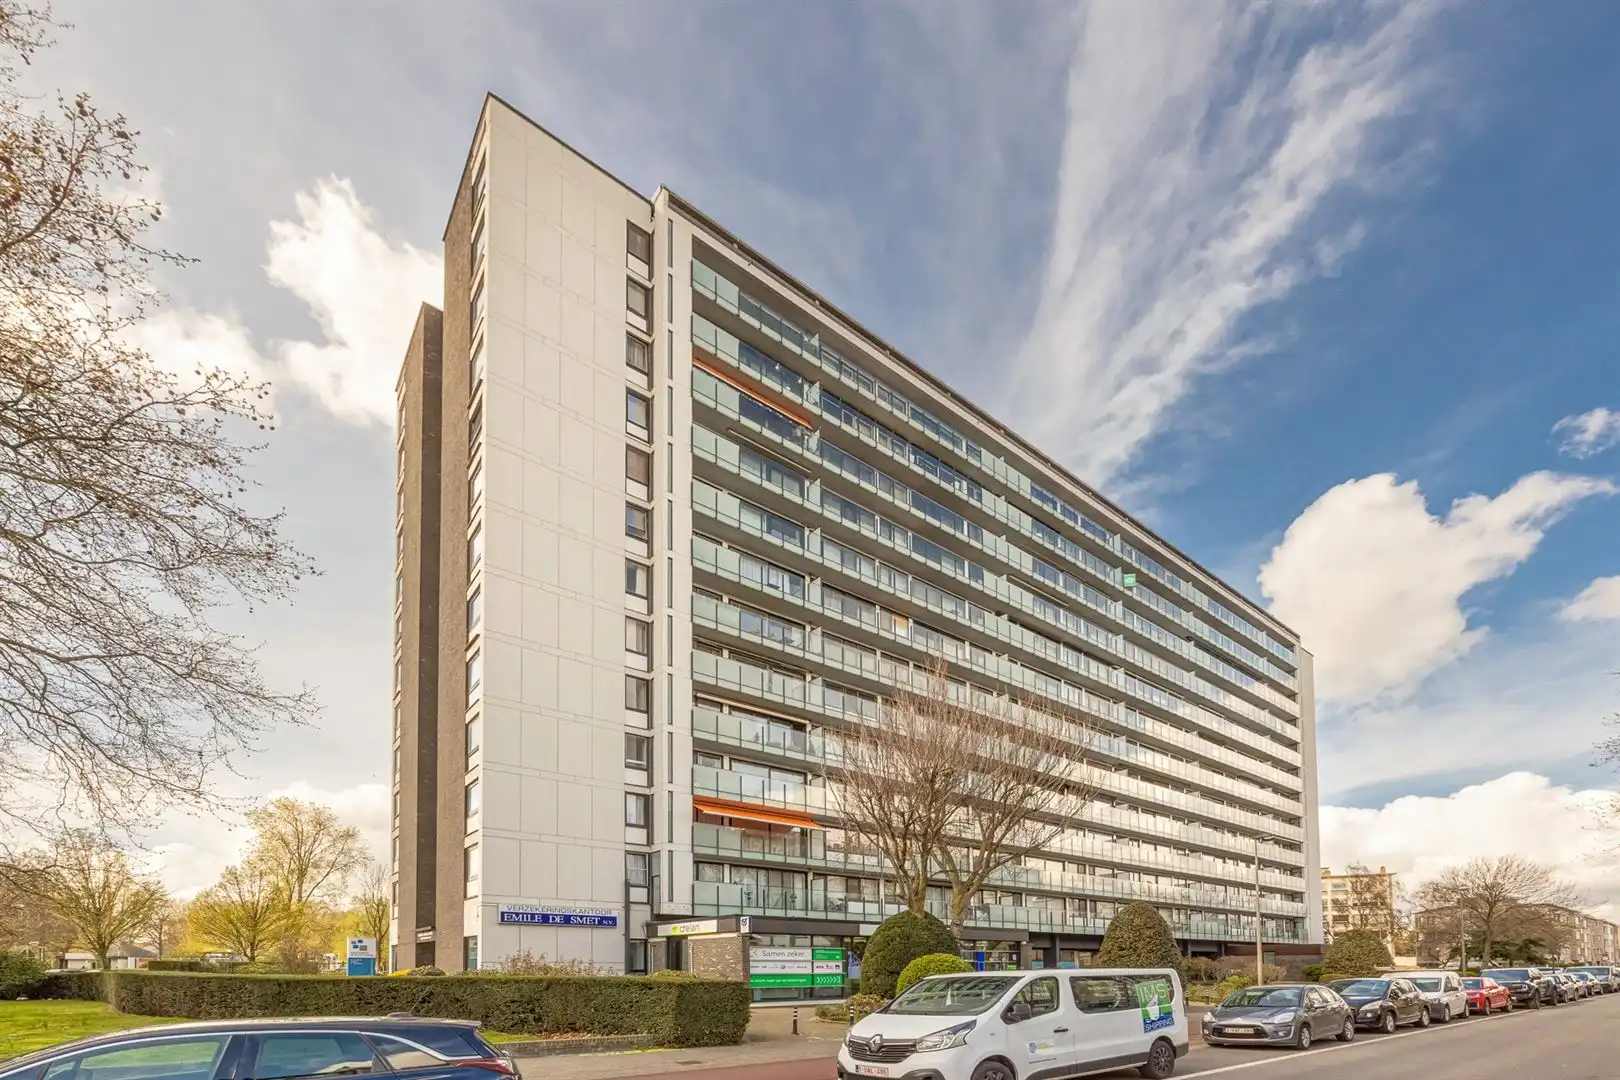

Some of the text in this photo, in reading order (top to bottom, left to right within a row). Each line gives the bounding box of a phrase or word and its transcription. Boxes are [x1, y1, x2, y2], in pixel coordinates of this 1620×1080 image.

[506, 904, 612, 915] VERZEKERINGSKANTOOR
[504, 913, 542, 923] EMILE
[549, 915, 565, 924] DE
[570, 916, 600, 925] SMET
[1139, 983, 1166, 1002] IMS
[1145, 1018, 1172, 1030] SHIPPING
